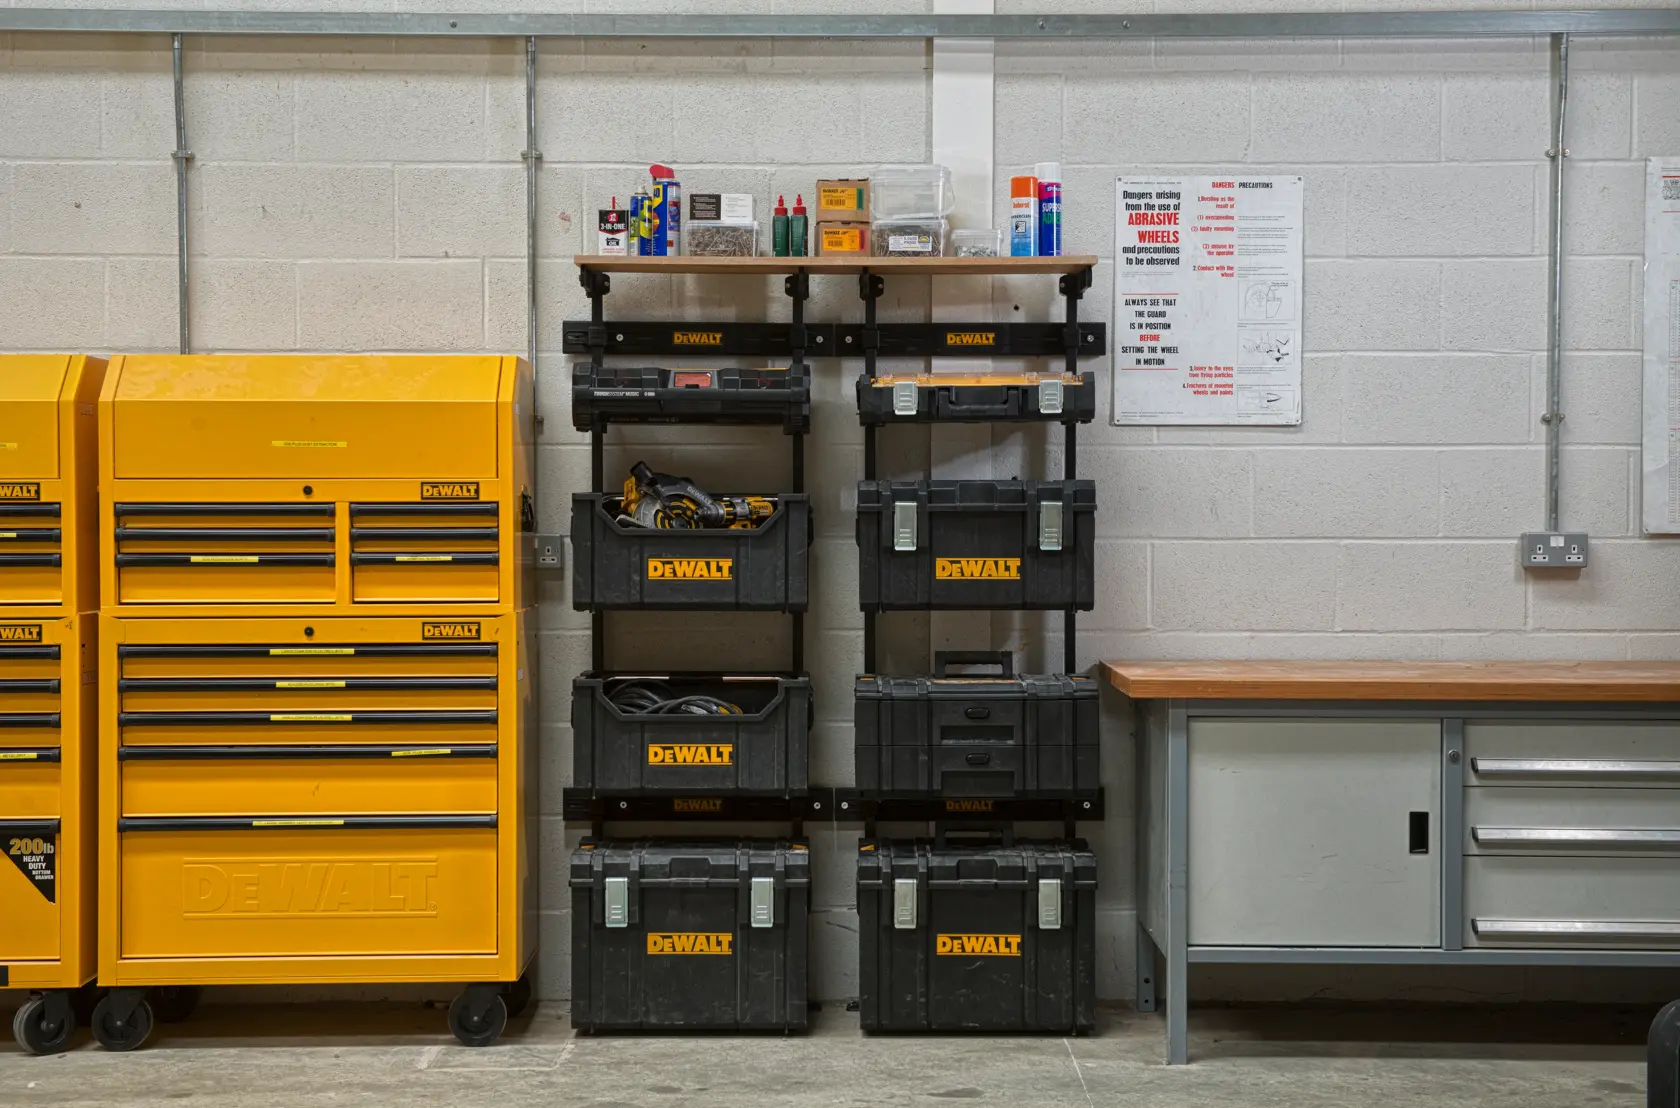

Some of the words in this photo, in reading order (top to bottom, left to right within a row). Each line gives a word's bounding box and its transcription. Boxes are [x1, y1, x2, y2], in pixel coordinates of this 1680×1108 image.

[1123, 190, 1153, 200] Dangers
[1156, 190, 1181, 200] arising
[1125, 202, 1142, 211] from
[1144, 202, 1156, 211] the
[1158, 203, 1171, 211] use
[1173, 202, 1180, 211] of
[1128, 212, 1179, 225] ABRASIVE
[1138, 230, 1179, 243] WHEELS
[1122, 245, 1136, 254] and
[1137, 245, 1180, 254] precautions
[1126, 257, 1133, 265] to
[1135, 257, 1144, 265] be
[1146, 257, 1180, 265] observed
[1130, 322, 1136, 330] IS
[1138, 322, 1143, 330] IN
[1145, 322, 1171, 330] POSITION
[1121, 346, 1145, 354] SETTING
[1147, 346, 1158, 354] THE
[1161, 346, 1179, 354] WHEEL
[1136, 358, 1141, 366] IN
[1143, 358, 1165, 366] MOTION
[0, 485, 37, 497] WALT
[0, 627, 39, 639] WALT
